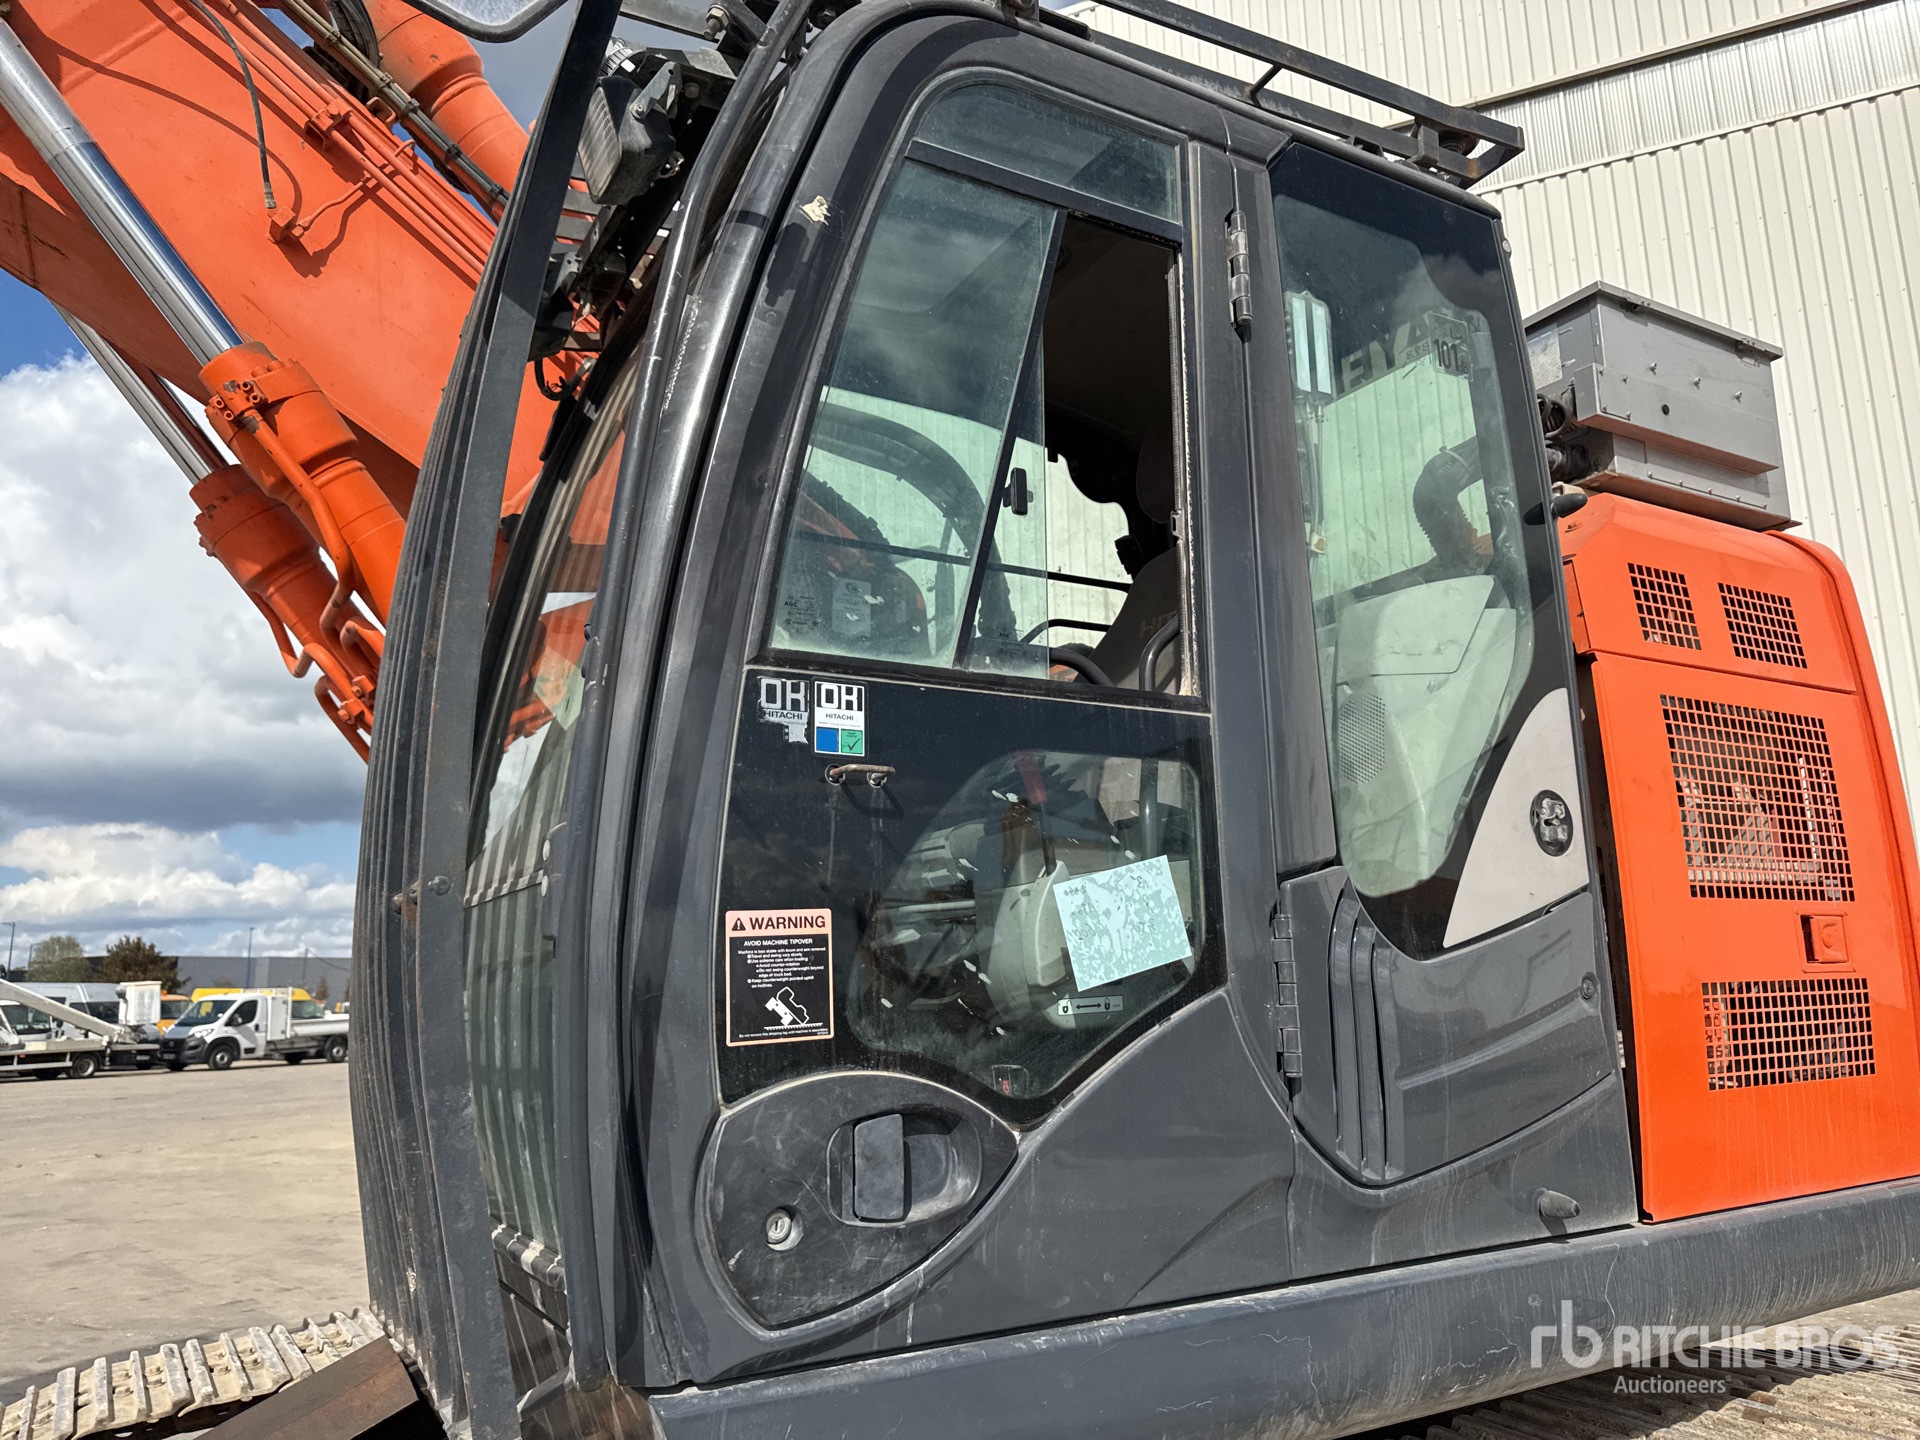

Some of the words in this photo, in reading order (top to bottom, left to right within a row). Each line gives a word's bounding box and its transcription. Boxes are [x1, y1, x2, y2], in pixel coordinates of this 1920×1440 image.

[1433, 338, 1459, 372] 101
[761, 678, 805, 711] OK
[821, 683, 858, 711] OK
[764, 710, 803, 720] HITACHI
[825, 713, 854, 721] HITACHI
[750, 916, 826, 930] WARNING
